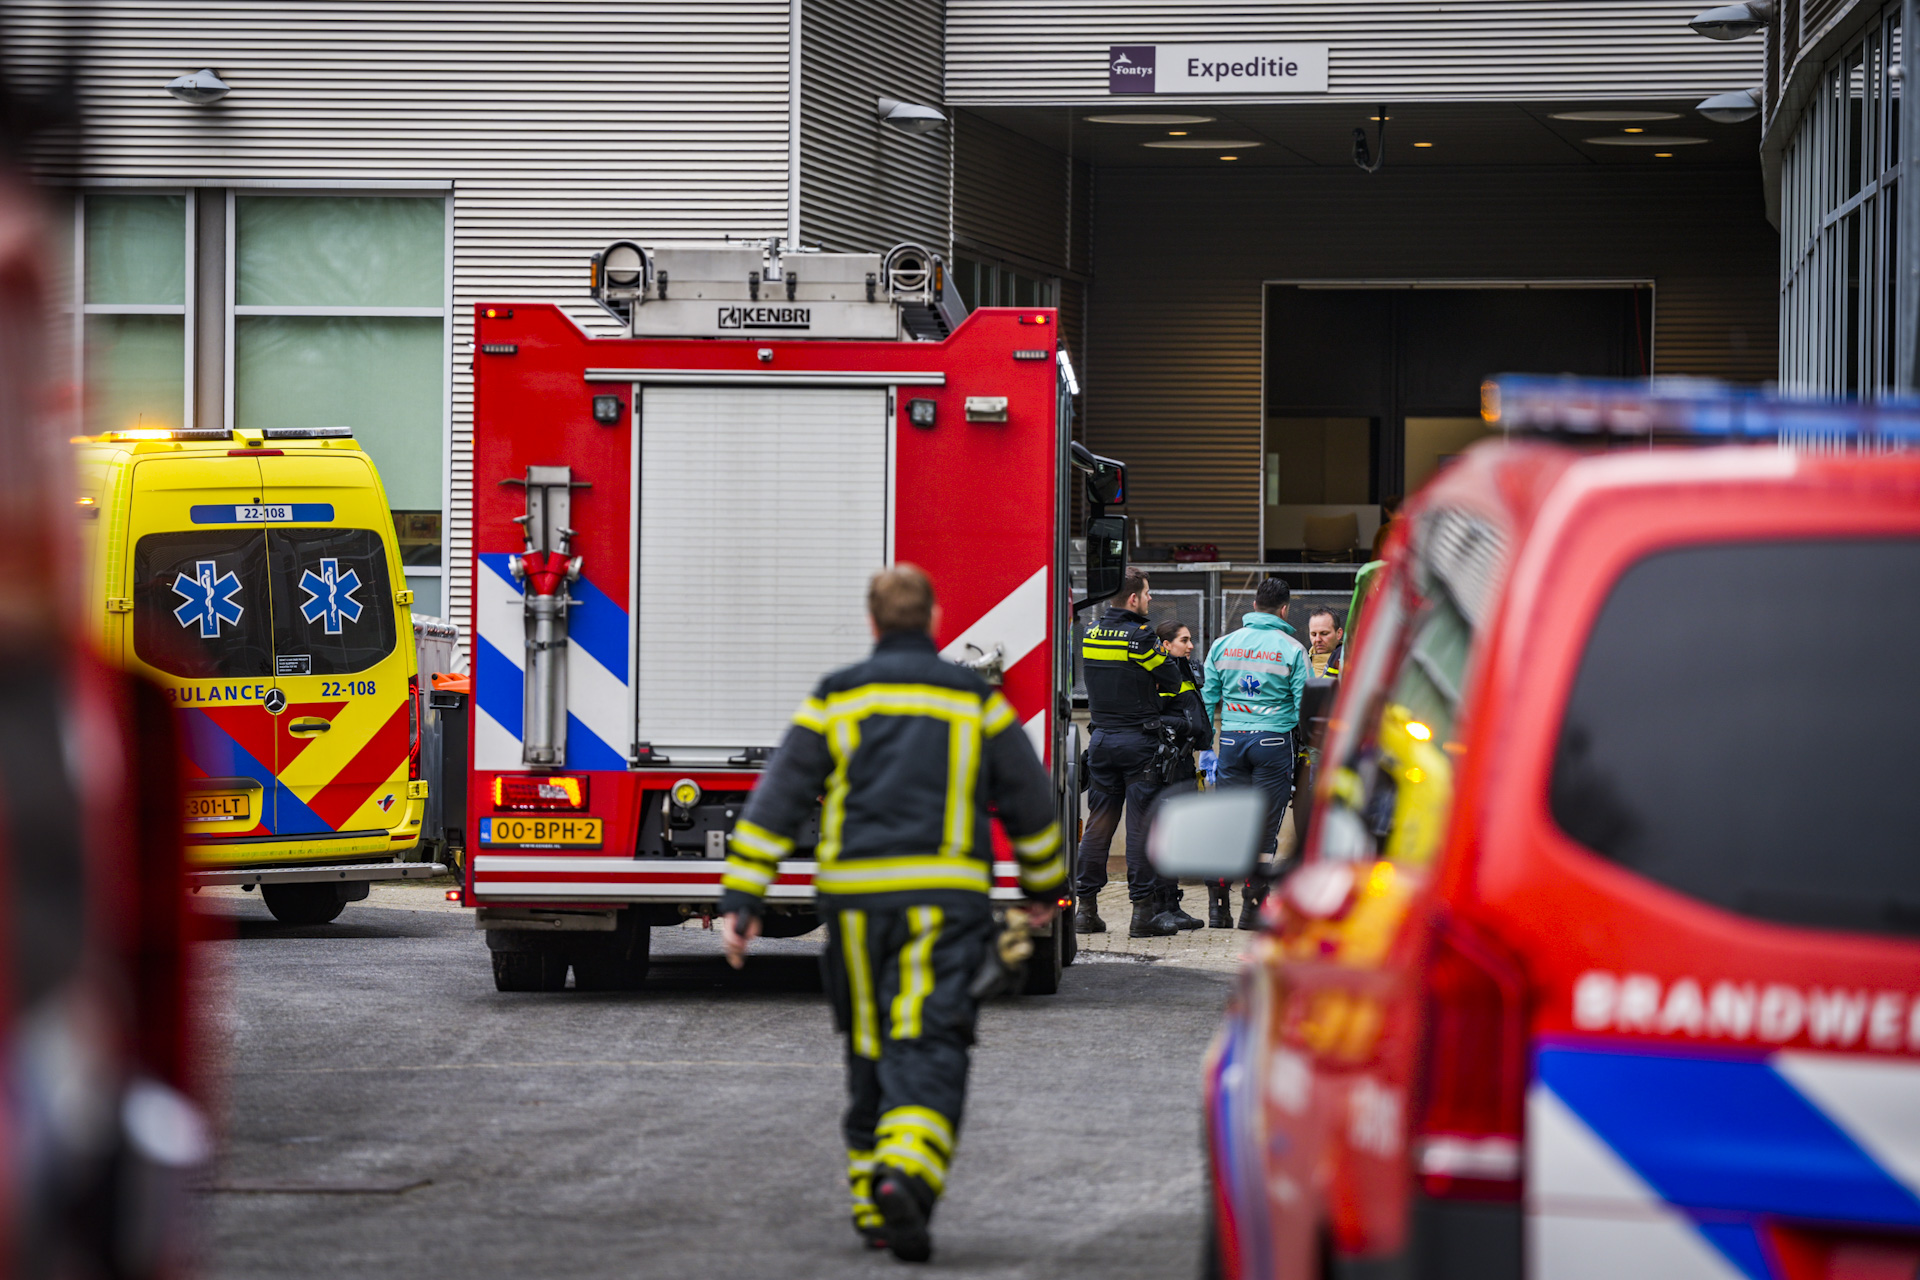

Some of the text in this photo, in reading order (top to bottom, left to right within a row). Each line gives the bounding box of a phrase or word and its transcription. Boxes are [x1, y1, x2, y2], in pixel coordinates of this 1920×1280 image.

[1115, 65, 1153, 78] Fontys
[1187, 56, 1299, 82] Expeditie
[742, 307, 810, 323] KENBRI
[244, 507, 285, 519] 22-108
[1222, 648, 1283, 663] AMBULANCE
[166, 684, 265, 703] BULANCE
[321, 680, 376, 697] 22-108
[185, 798, 240, 815] -301-LT
[497, 821, 596, 840] 00-BPH-2
